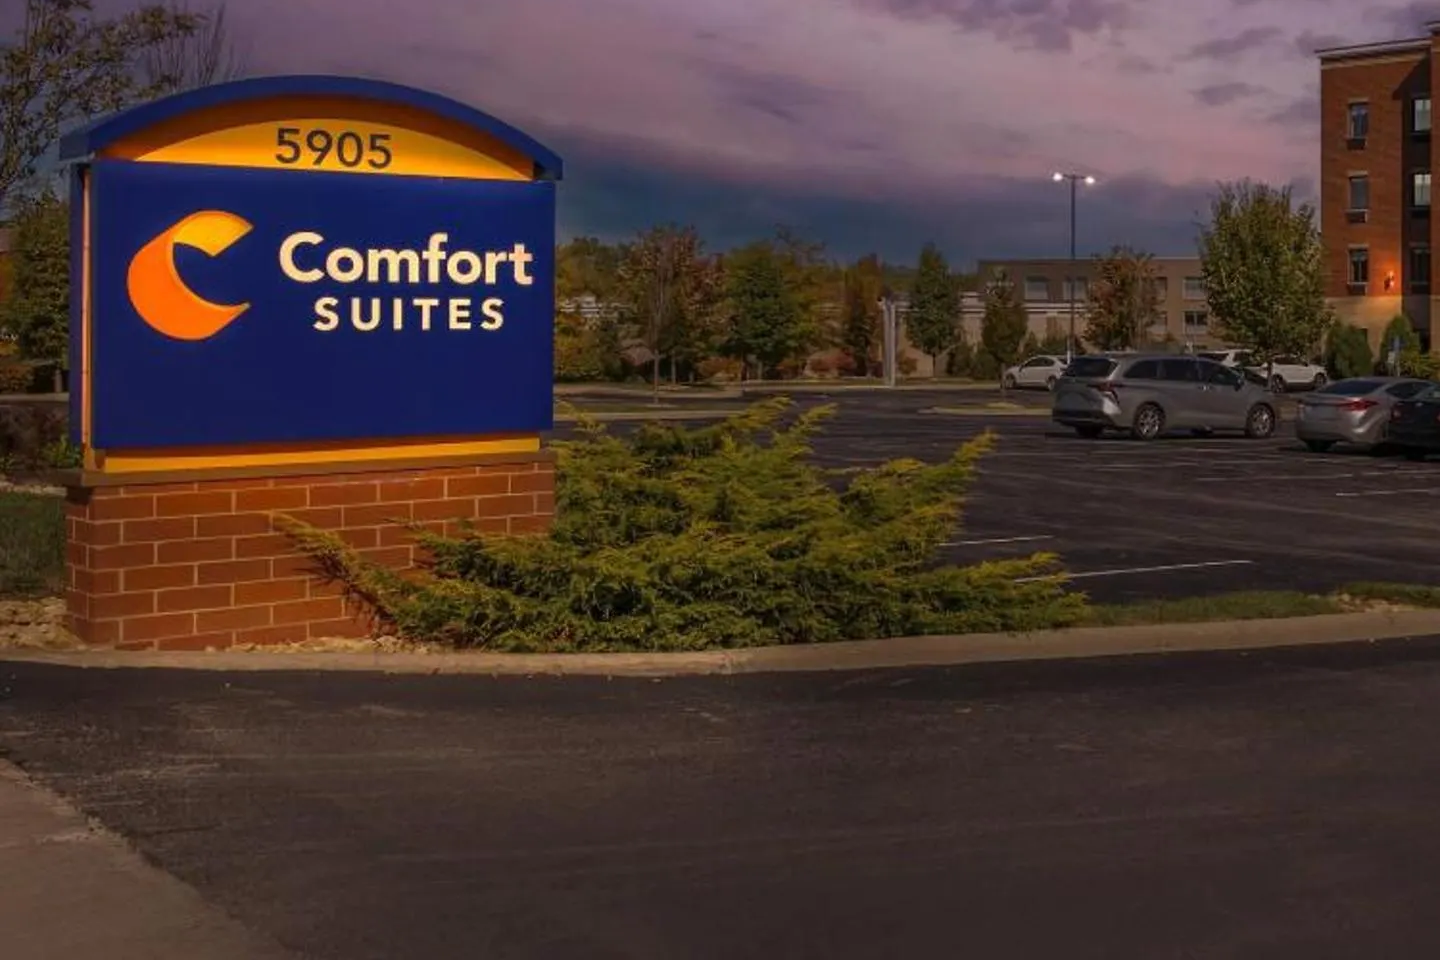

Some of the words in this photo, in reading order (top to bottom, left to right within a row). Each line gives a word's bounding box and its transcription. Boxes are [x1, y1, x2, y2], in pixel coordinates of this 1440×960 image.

[275, 128, 392, 169] 5905
[278, 232, 534, 285] Comfort
[313, 297, 505, 331] SUITES
